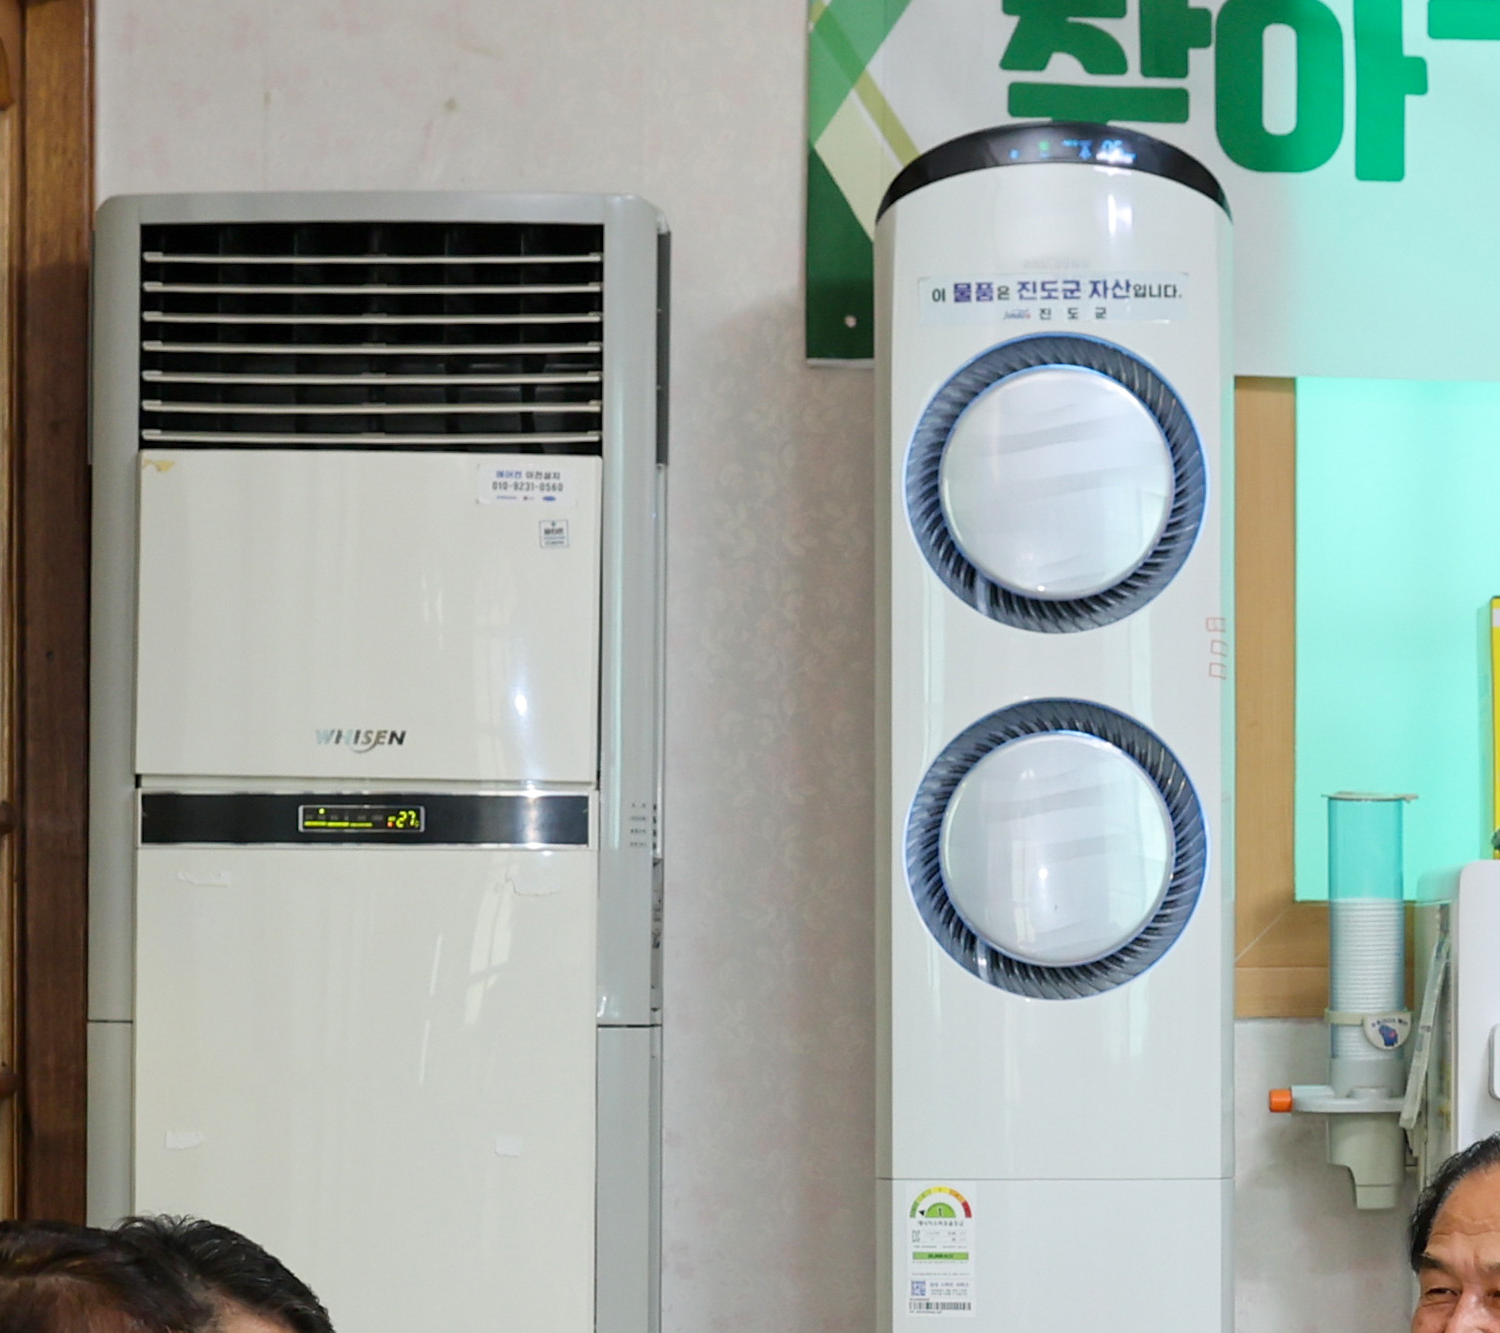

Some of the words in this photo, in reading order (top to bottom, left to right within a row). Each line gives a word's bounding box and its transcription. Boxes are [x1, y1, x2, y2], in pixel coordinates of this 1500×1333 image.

[932, 288, 946, 302] 이
[953, 282, 1011, 302] 물품은
[1017, 280, 1081, 302] 진도군
[315, 729, 407, 749] WHISEN
